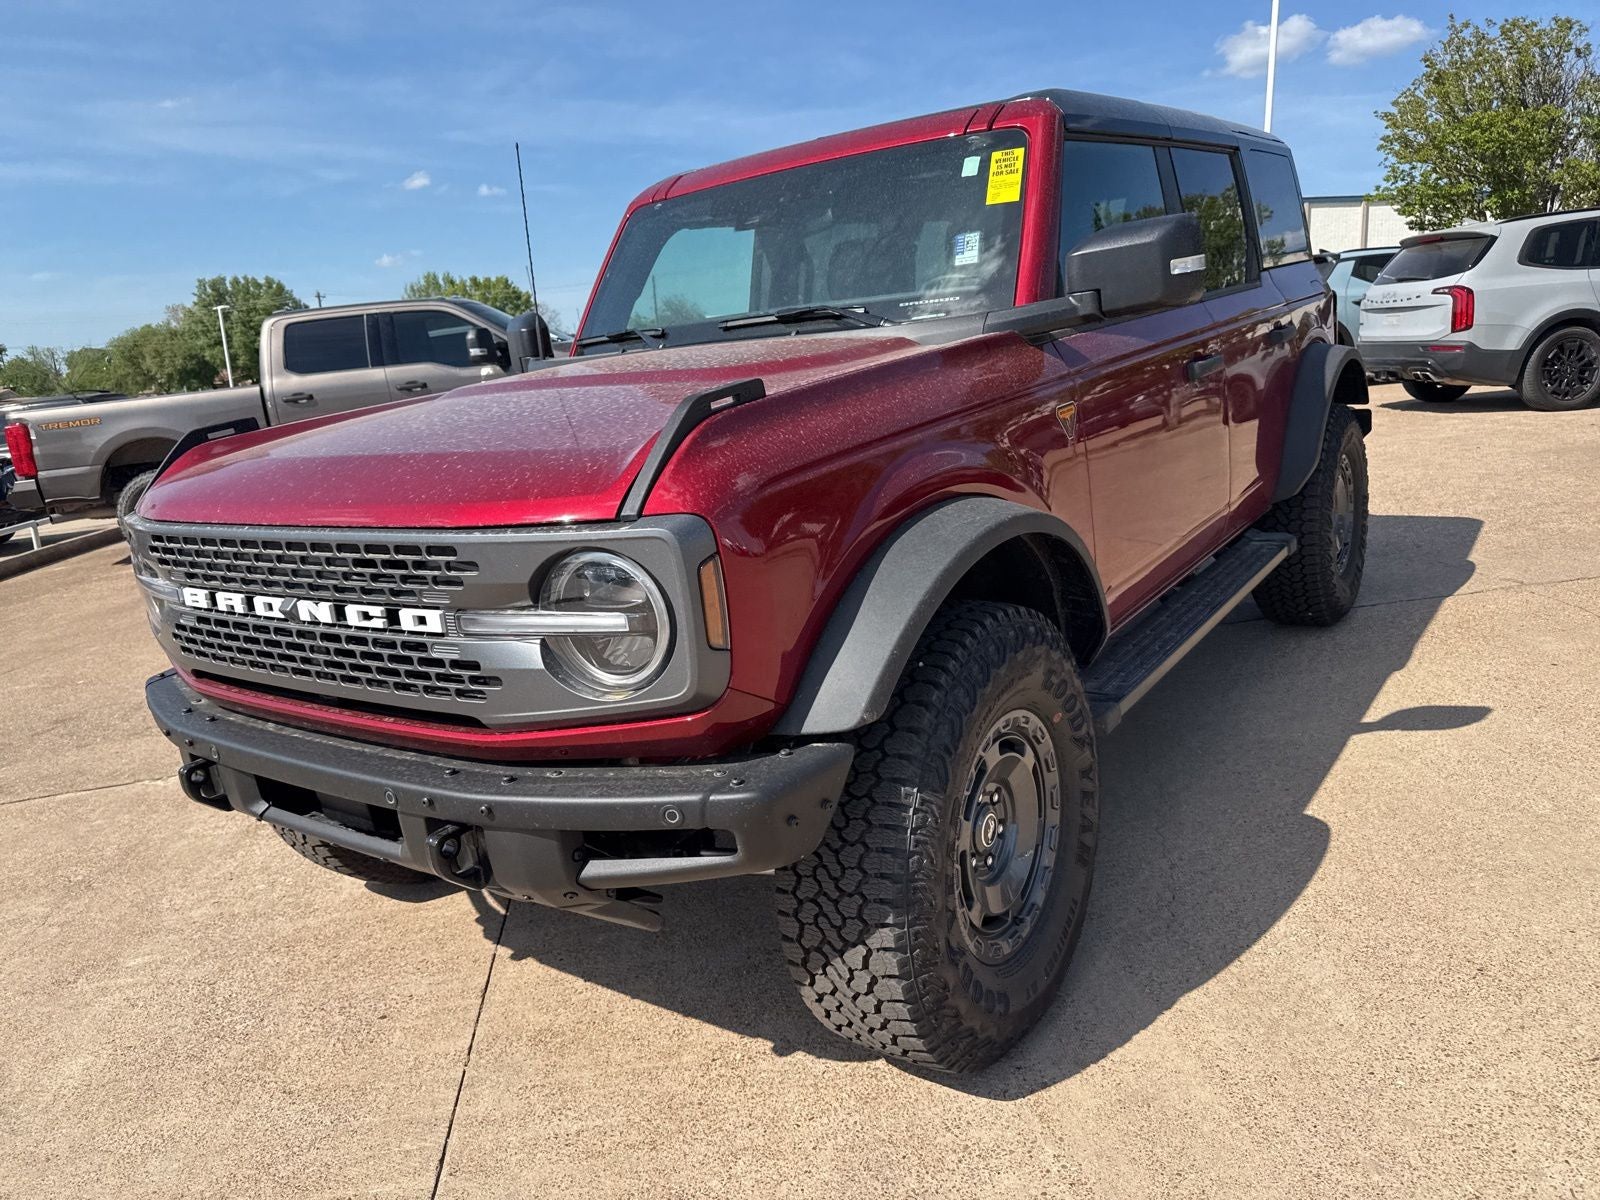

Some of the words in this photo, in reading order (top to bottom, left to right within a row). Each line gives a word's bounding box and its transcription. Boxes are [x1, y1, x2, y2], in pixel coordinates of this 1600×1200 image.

[995, 156, 1019, 164] VEHICLE
[1005, 168, 1019, 176] SALE
[39, 417, 102, 431] TREMOR
[182, 587, 446, 634] BRONCO
